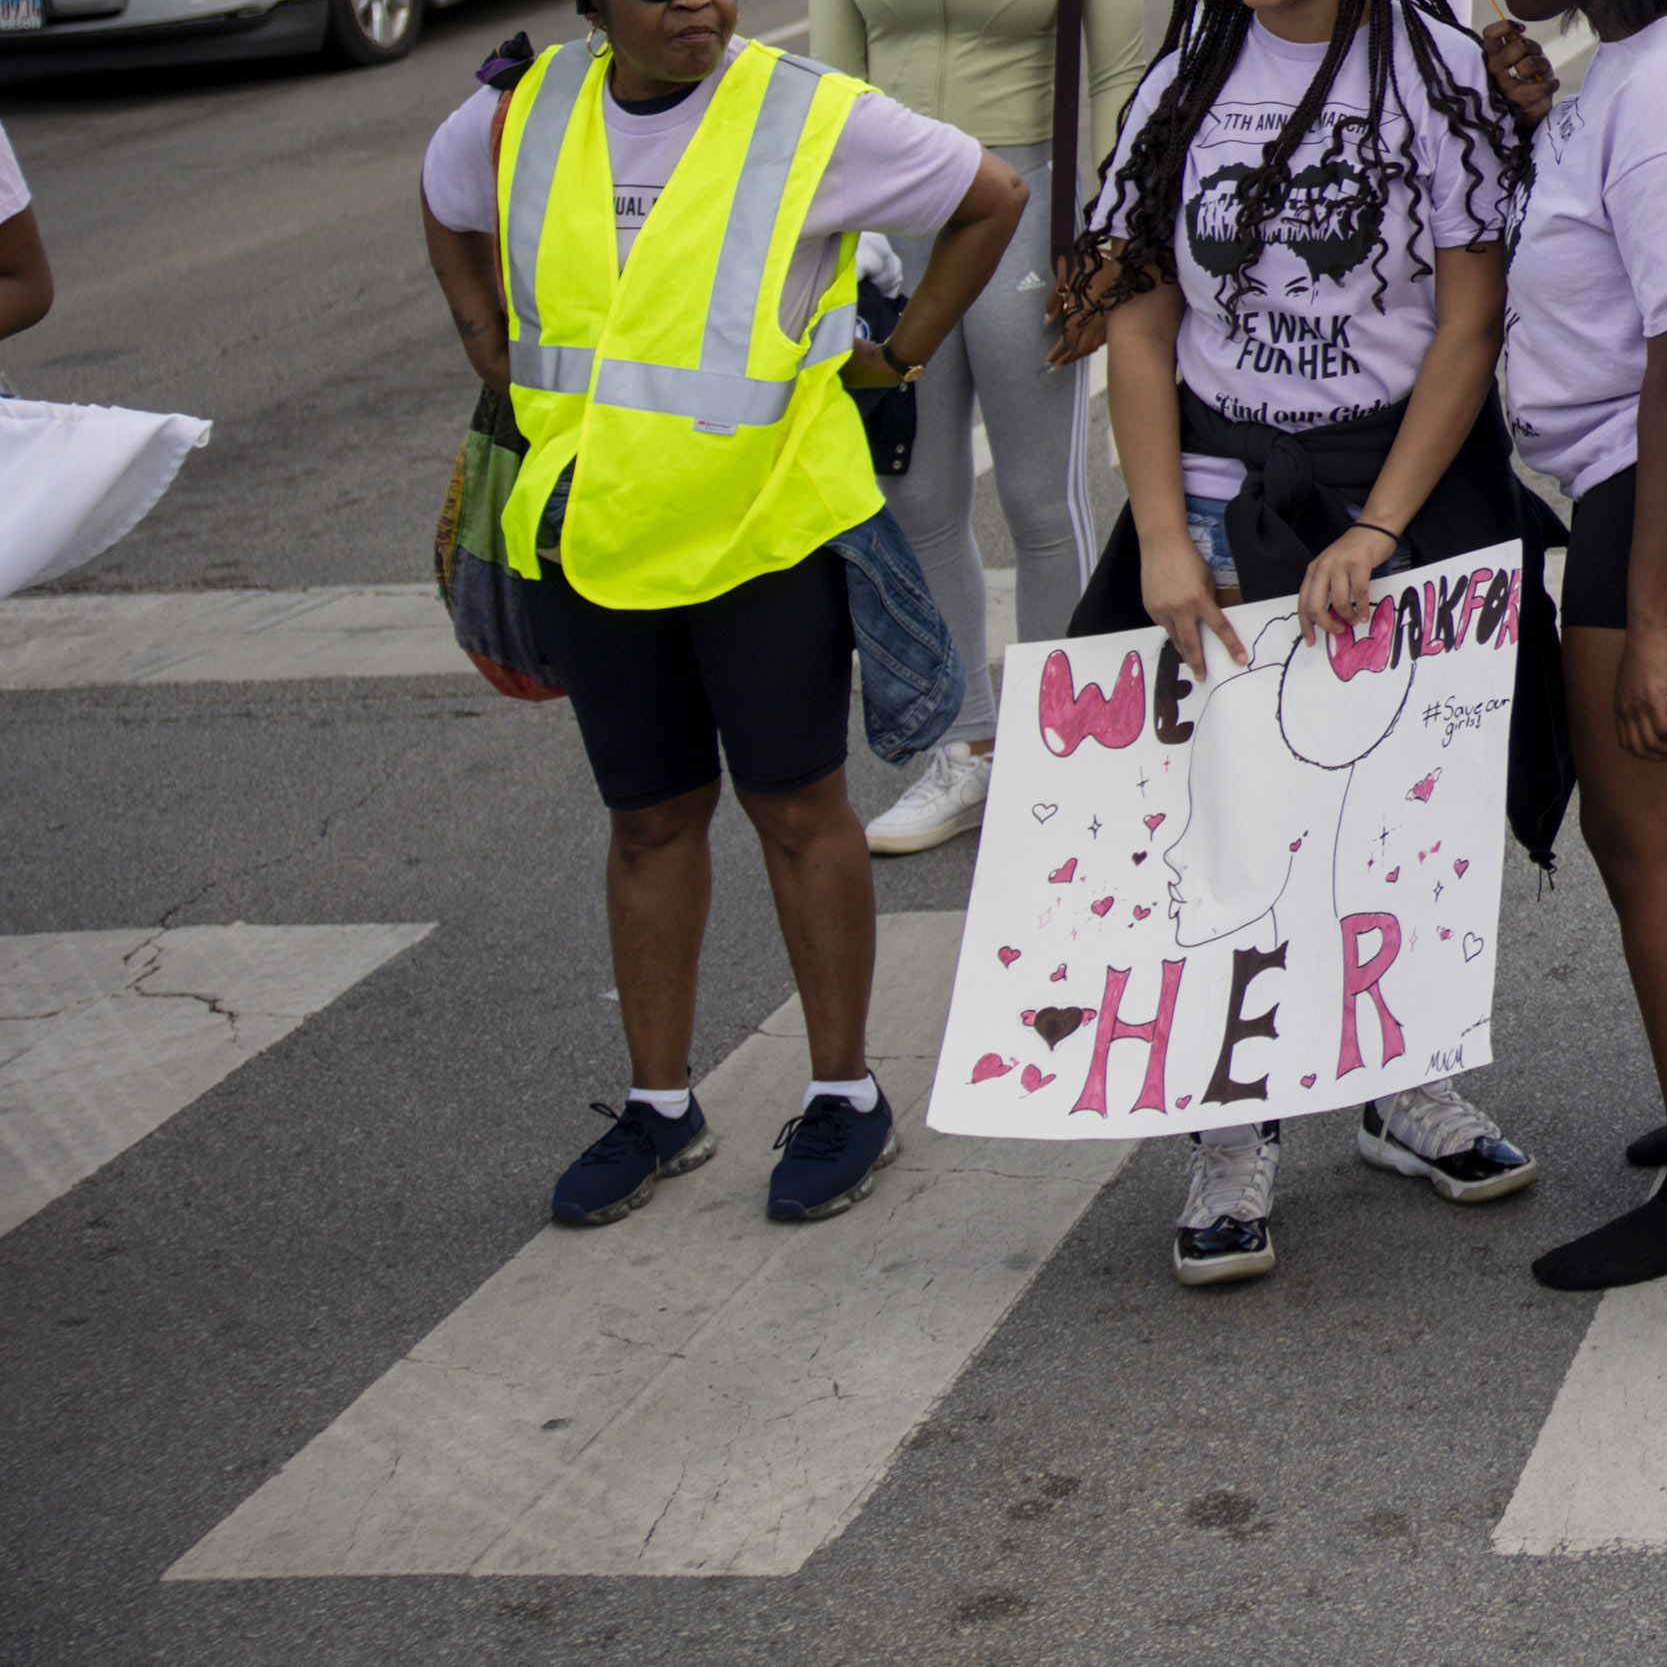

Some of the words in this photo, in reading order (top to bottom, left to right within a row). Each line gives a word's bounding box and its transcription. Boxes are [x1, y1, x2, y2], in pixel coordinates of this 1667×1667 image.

[1224, 113, 1256, 131] 7TH
[1268, 311, 1351, 348] WALK
[1298, 342, 1360, 380] HER
[1273, 409, 1323, 424] our
[1039, 636, 1195, 758] WE
[1326, 575, 1469, 683] WALK
[1454, 567, 1522, 650] FOR
[1422, 696, 1483, 727] #Save
[1486, 698, 1510, 712] our
[1442, 715, 1481, 747] girls!
